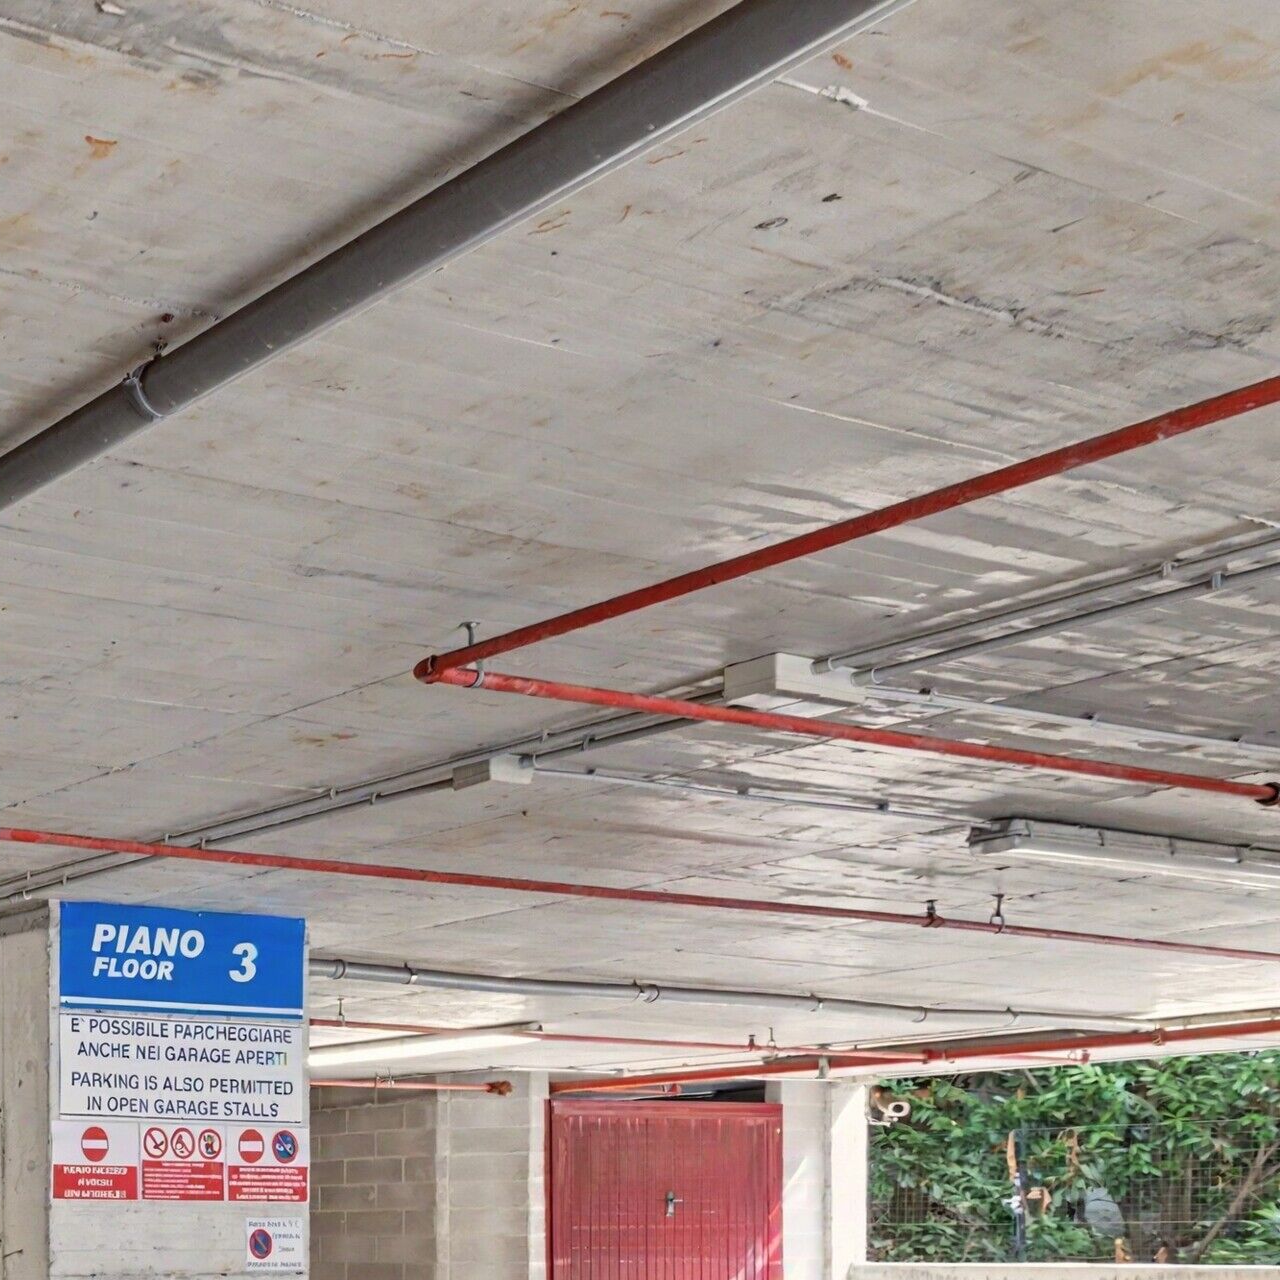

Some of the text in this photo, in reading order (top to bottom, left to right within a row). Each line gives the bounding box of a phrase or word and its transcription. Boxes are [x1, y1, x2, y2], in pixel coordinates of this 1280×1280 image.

[91, 923, 205, 958] PIANO
[92, 956, 174, 981] FLOOR
[228, 942, 259, 982] 3
[89, 1019, 169, 1038] POSSIBILE
[174, 1024, 292, 1044] PARCHEGGIARE
[77, 1041, 287, 1066] ANCHE NEI GARAGE APERTI
[71, 1071, 293, 1095] PARKING IS ALSO PERMITTED
[87, 1096, 279, 1117] IN OPEN GARAGE STALLS
